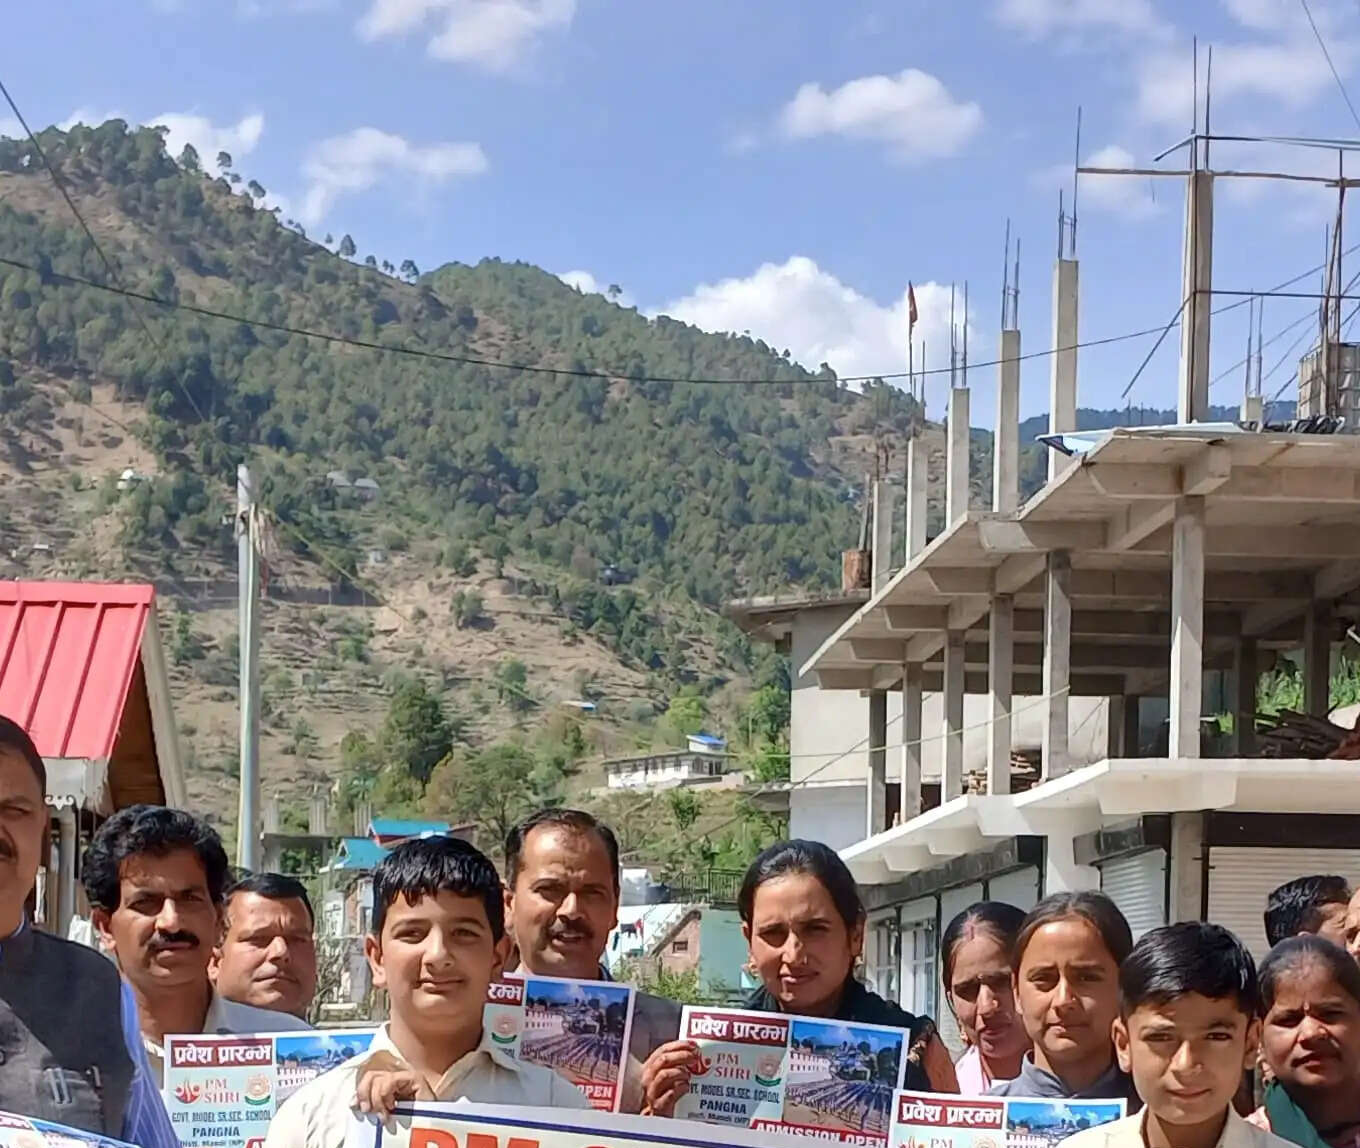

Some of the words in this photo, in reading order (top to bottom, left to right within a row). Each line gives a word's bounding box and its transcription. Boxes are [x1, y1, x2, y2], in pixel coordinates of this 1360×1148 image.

[488, 983, 524, 1001] रम्भ
[690, 1015, 728, 1036] प्रवेश
[732, 1021, 788, 1041] प्रारम्भ
[173, 1043, 213, 1064] प्रवेश
[217, 1044, 272, 1064] प्रारम्भ
[717, 1053, 739, 1065] PM
[715, 1068, 750, 1081] SHRI
[205, 1079, 227, 1089] PM
[204, 1091, 240, 1104] SHRI
[700, 1099, 747, 1114] PANGNA
[901, 1100, 942, 1123] प्रवेश
[946, 1106, 1003, 1125] प्रारम्भ
[246, 1109, 271, 1121] SCHOOL
[192, 1126, 240, 1137] PANGNA
[756, 1122, 841, 1143] ADMISSION
[845, 1134, 888, 1148] OPEN
